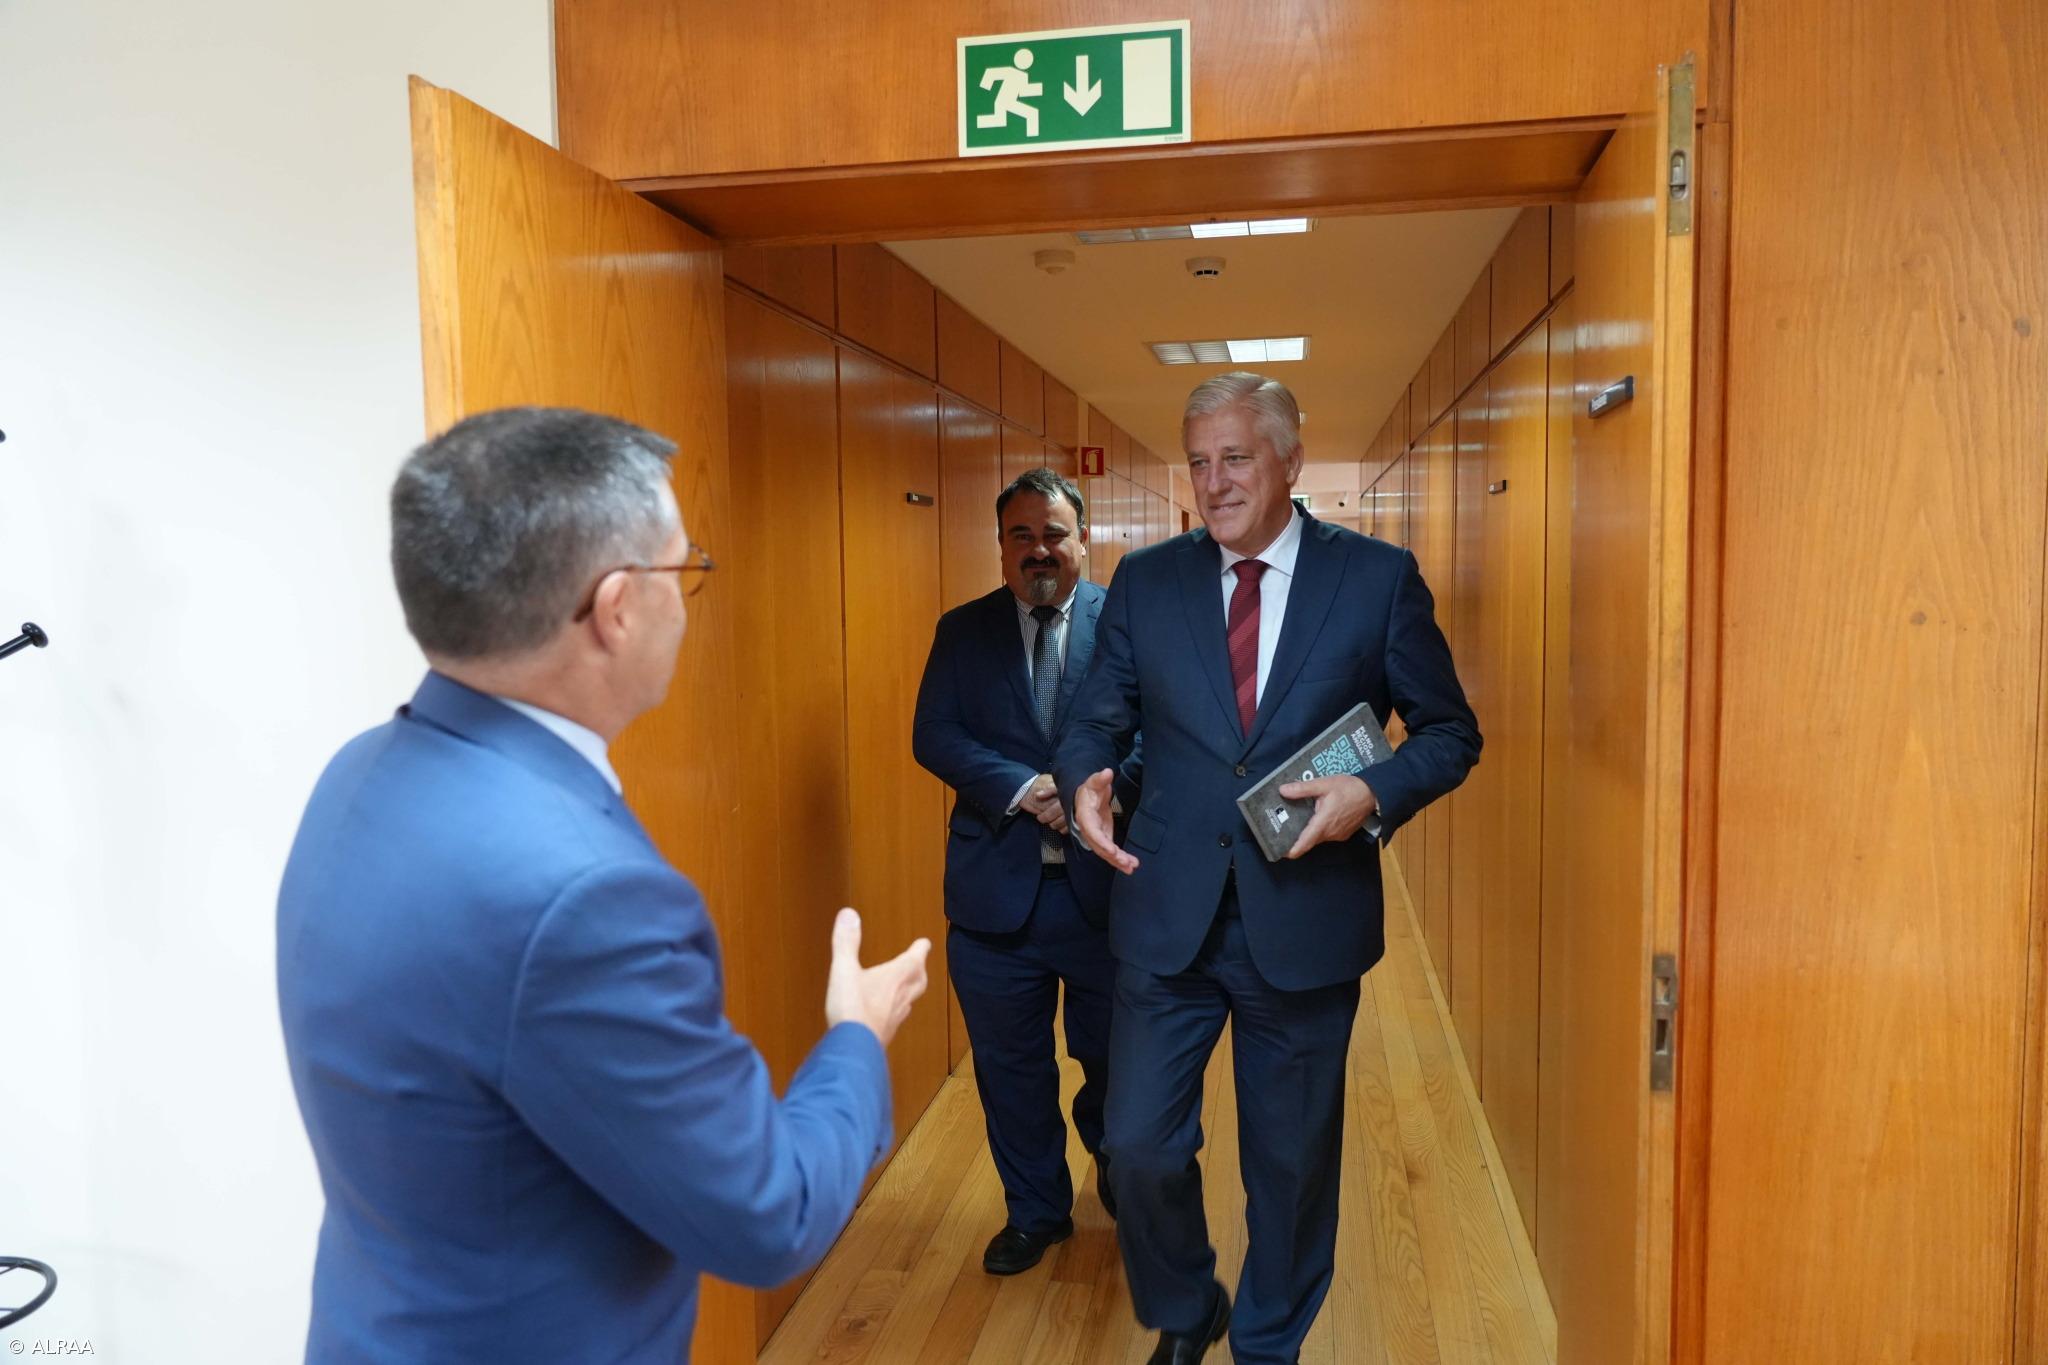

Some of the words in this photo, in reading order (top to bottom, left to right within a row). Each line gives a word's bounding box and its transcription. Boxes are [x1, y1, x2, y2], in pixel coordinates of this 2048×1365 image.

[1350, 733, 1364, 756] ANUAL
[1354, 728, 1375, 764] REGIONAL
[1358, 725, 1374, 750] PLANO
